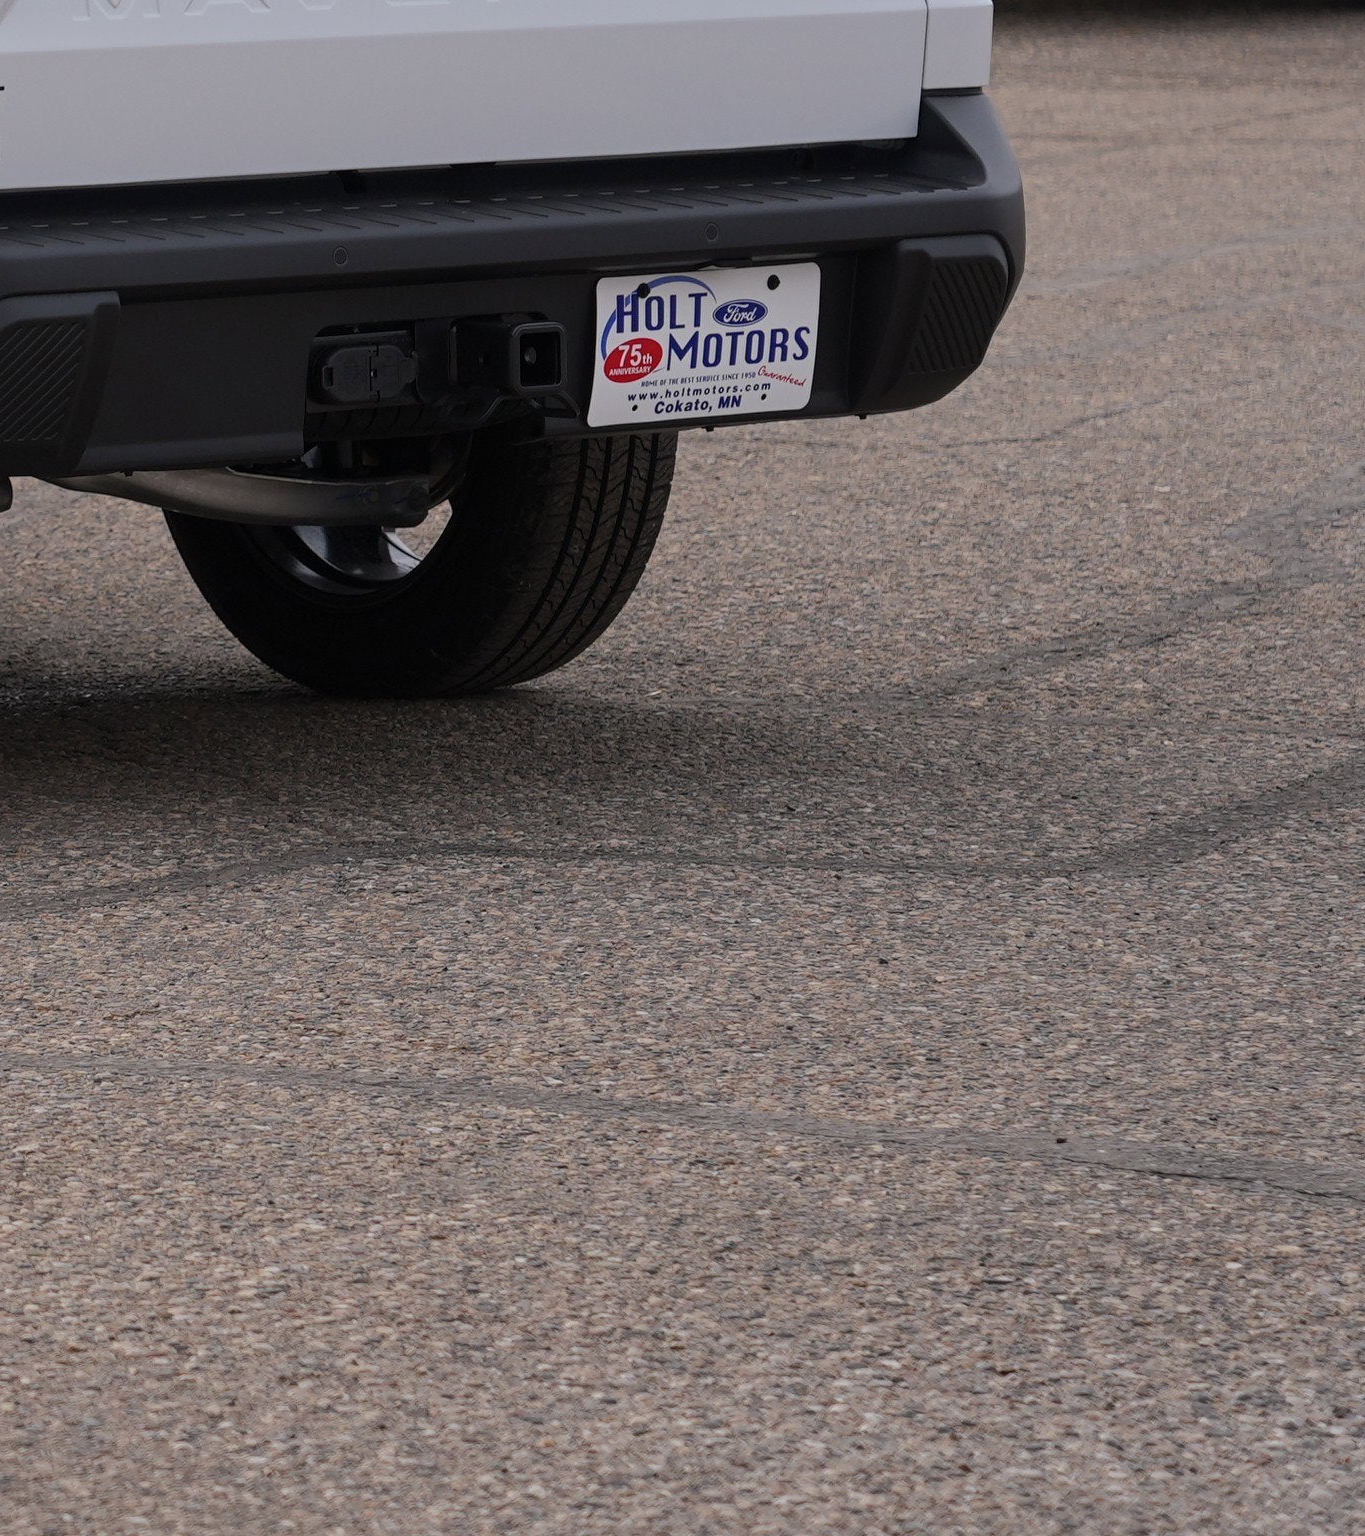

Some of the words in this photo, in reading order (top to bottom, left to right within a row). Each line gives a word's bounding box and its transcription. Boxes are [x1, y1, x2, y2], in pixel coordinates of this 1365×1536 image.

[616, 292, 708, 333] HOLT
[723, 303, 758, 323] Ford
[619, 343, 653, 367] 75th
[667, 326, 811, 371] MOTORS
[609, 365, 652, 376] ANNIVERSARY
[641, 379, 658, 387] HOME
[668, 377, 679, 385] THE
[680, 376, 694, 384] BEST
[696, 374, 720, 383] SERVICE
[721, 373, 739, 381] SINCE
[741, 371, 757, 379] 1950
[758, 365, 807, 387] Guaranteed
[628, 382, 771, 401] www.holtmotors.com
[654, 398, 713, 414] Cokato,
[717, 395, 742, 409] MN
